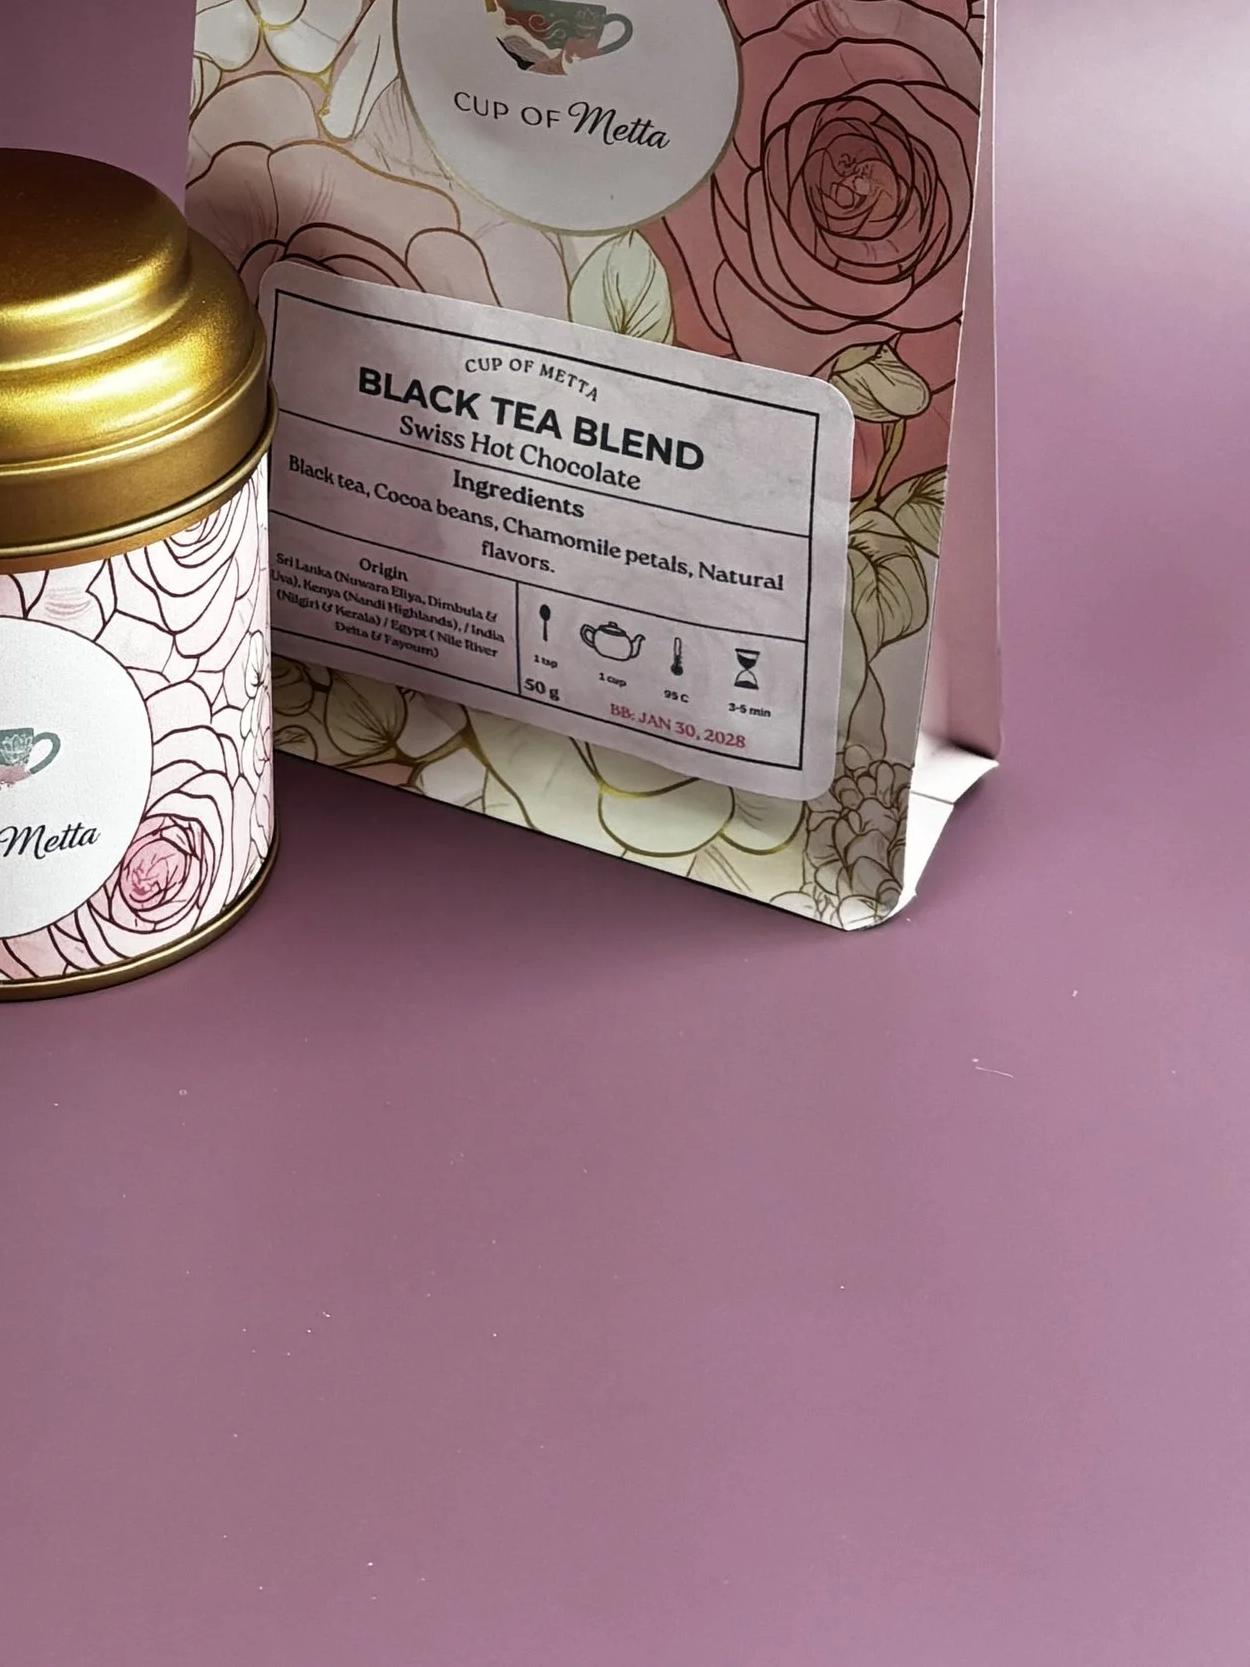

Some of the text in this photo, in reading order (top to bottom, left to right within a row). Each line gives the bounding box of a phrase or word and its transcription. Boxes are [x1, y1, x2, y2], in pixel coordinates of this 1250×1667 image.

[454, 91, 670, 149] CUP OF Metta
[465, 357, 598, 402] CUP OF METTA
[358, 366, 704, 471] BLACK TEA BLEND
[399, 415, 641, 490] Swiss Hot Chocolate
[452, 469, 585, 518] Ingredients
[288, 454, 784, 591] Black tea, Cocoa beans, Chamomile petals, Natural
[359, 557, 409, 582] Origin
[481, 540, 556, 574] flavors.
[276, 553, 293, 567] Sri
[295, 558, 332, 579] Lanka
[334, 570, 389, 595] (Nuwara
[428, 595, 483, 620] Dimbula
[485, 611, 498, 623] &
[303, 579, 341, 599] Kenya
[343, 590, 386, 610] (Nandi
[471, 624, 505, 643] India
[321, 601, 333, 613] &
[335, 604, 381, 627] Kerala)
[391, 619, 428, 638] Egypt
[465, 639, 498, 657] River
[335, 621, 439, 658] Delta & Fayoum)
[533, 654, 540, 664] 1
[598, 672, 627, 688] 1 cup
[524, 678, 560, 702] 50 g
[664, 689, 679, 701] 95
[728, 702, 772, 718] 3-5 min
[610, 702, 746, 749] BB: JAN 30, 2028
